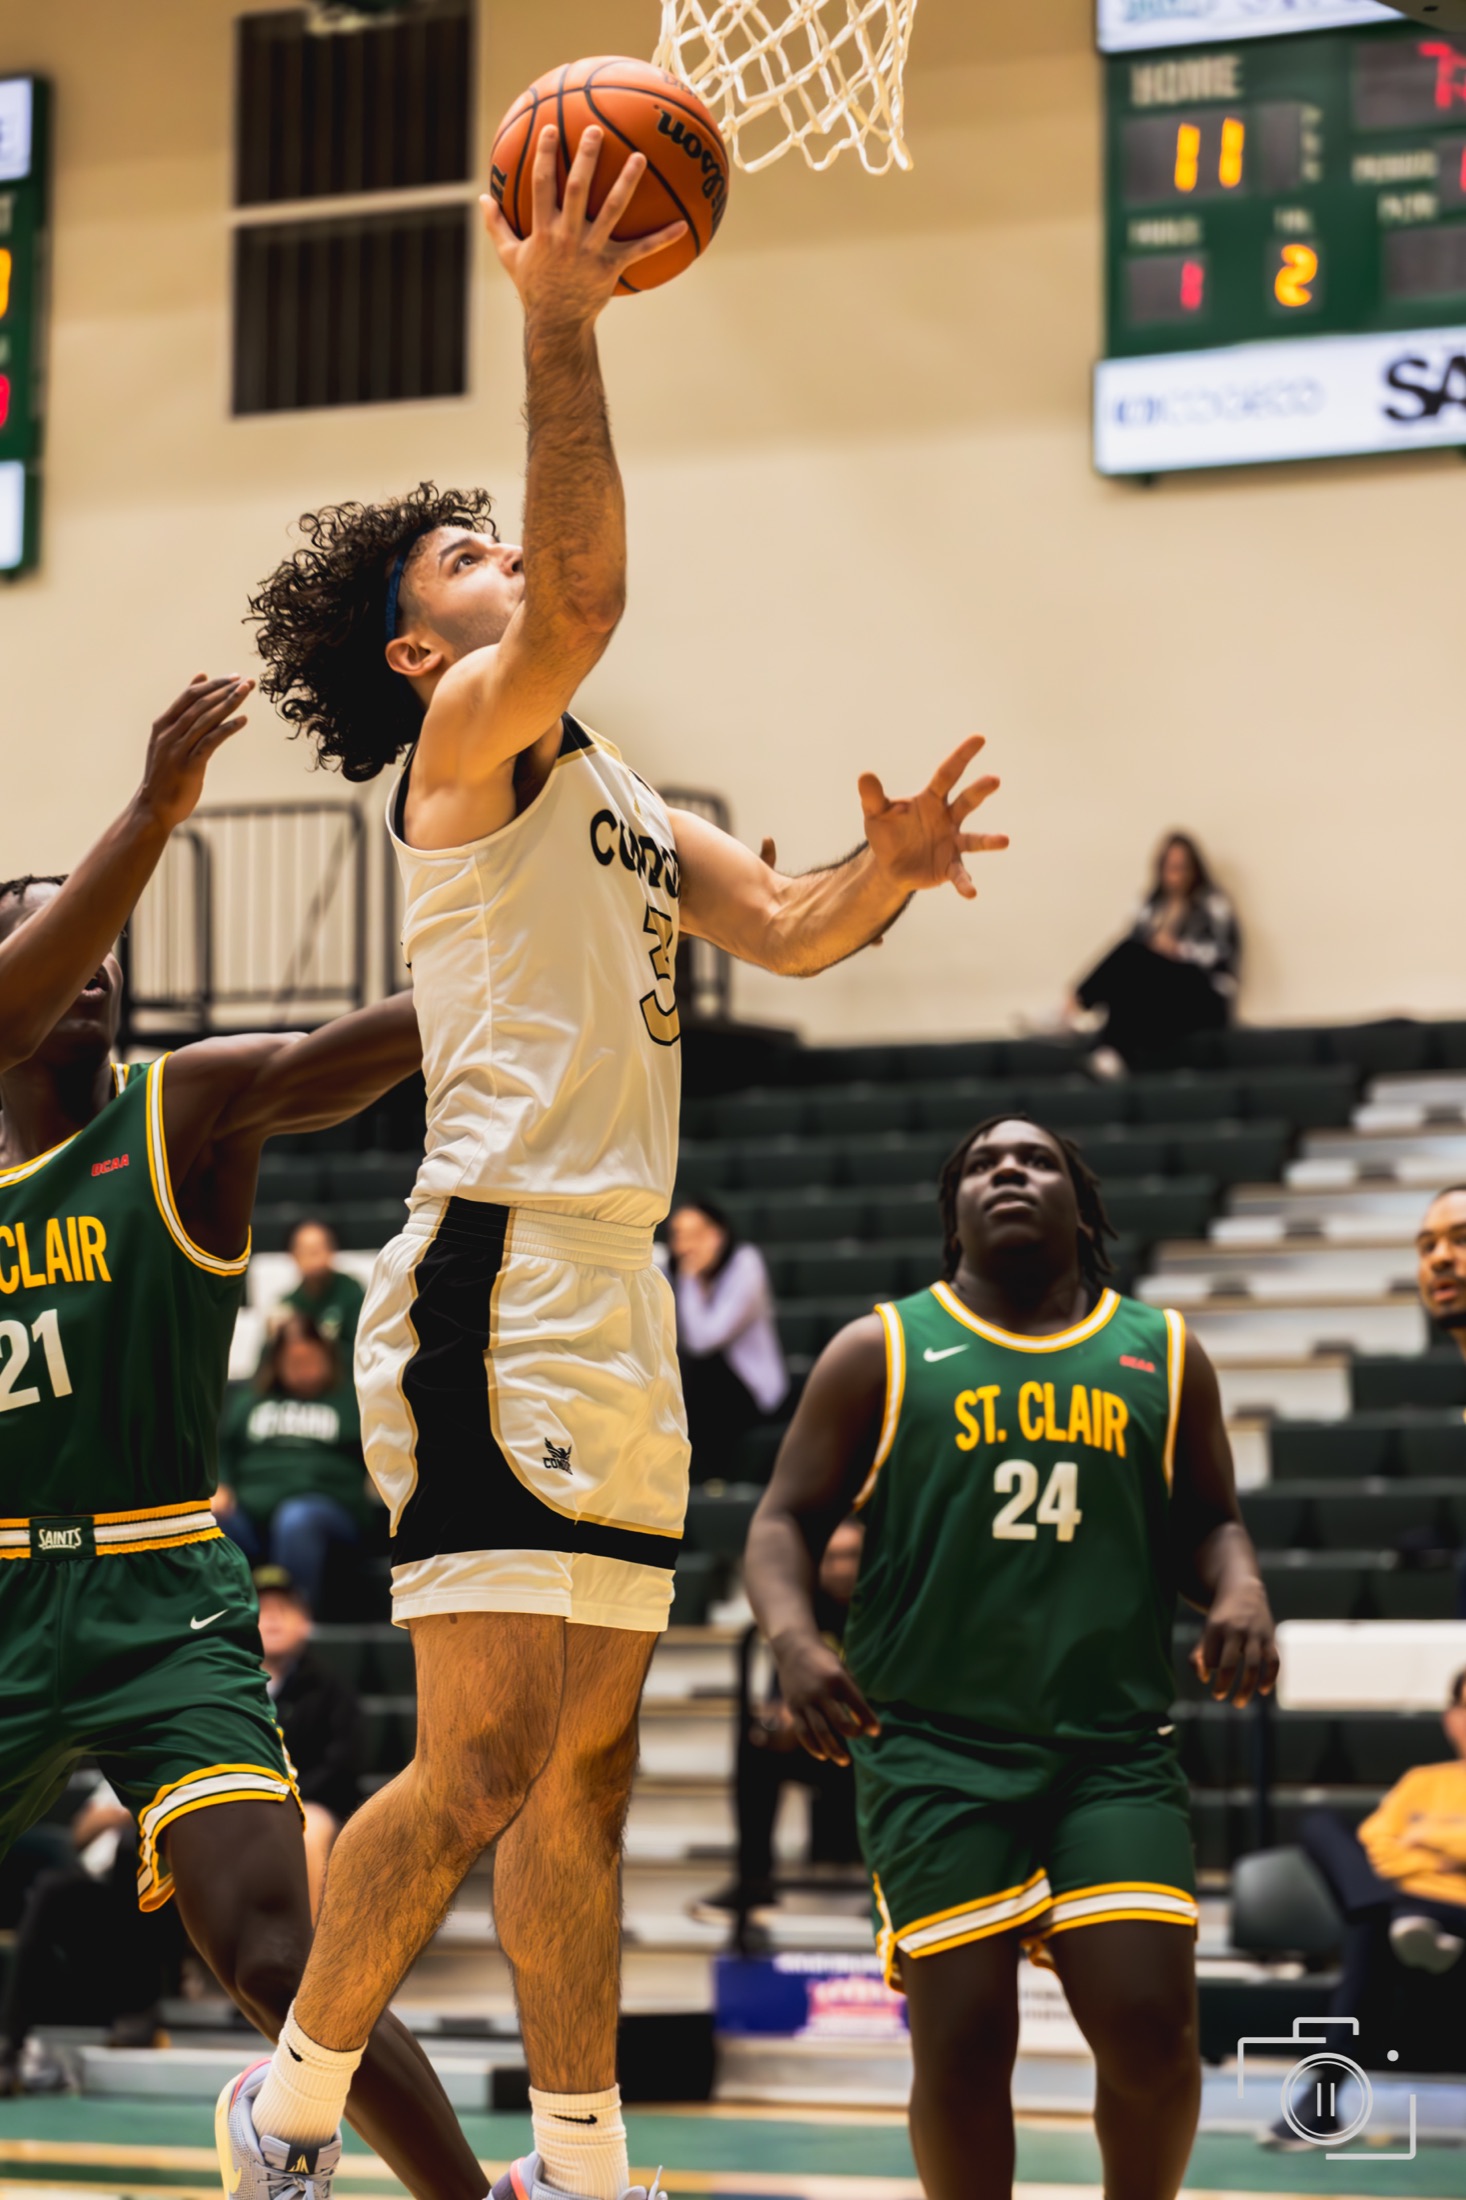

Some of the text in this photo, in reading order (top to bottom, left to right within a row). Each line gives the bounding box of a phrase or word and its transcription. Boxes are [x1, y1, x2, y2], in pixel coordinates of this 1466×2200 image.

[1174, 116, 1244, 192] 11
[1275, 244, 1318, 307] 2
[0, 1216, 112, 1294] CLAIR
[0, 1309, 73, 1412] 21
[954, 1380, 1129, 1459] ST. CLAIR
[38, 1527, 82, 1550] SAINTS
[992, 1459, 1082, 1542] 24
